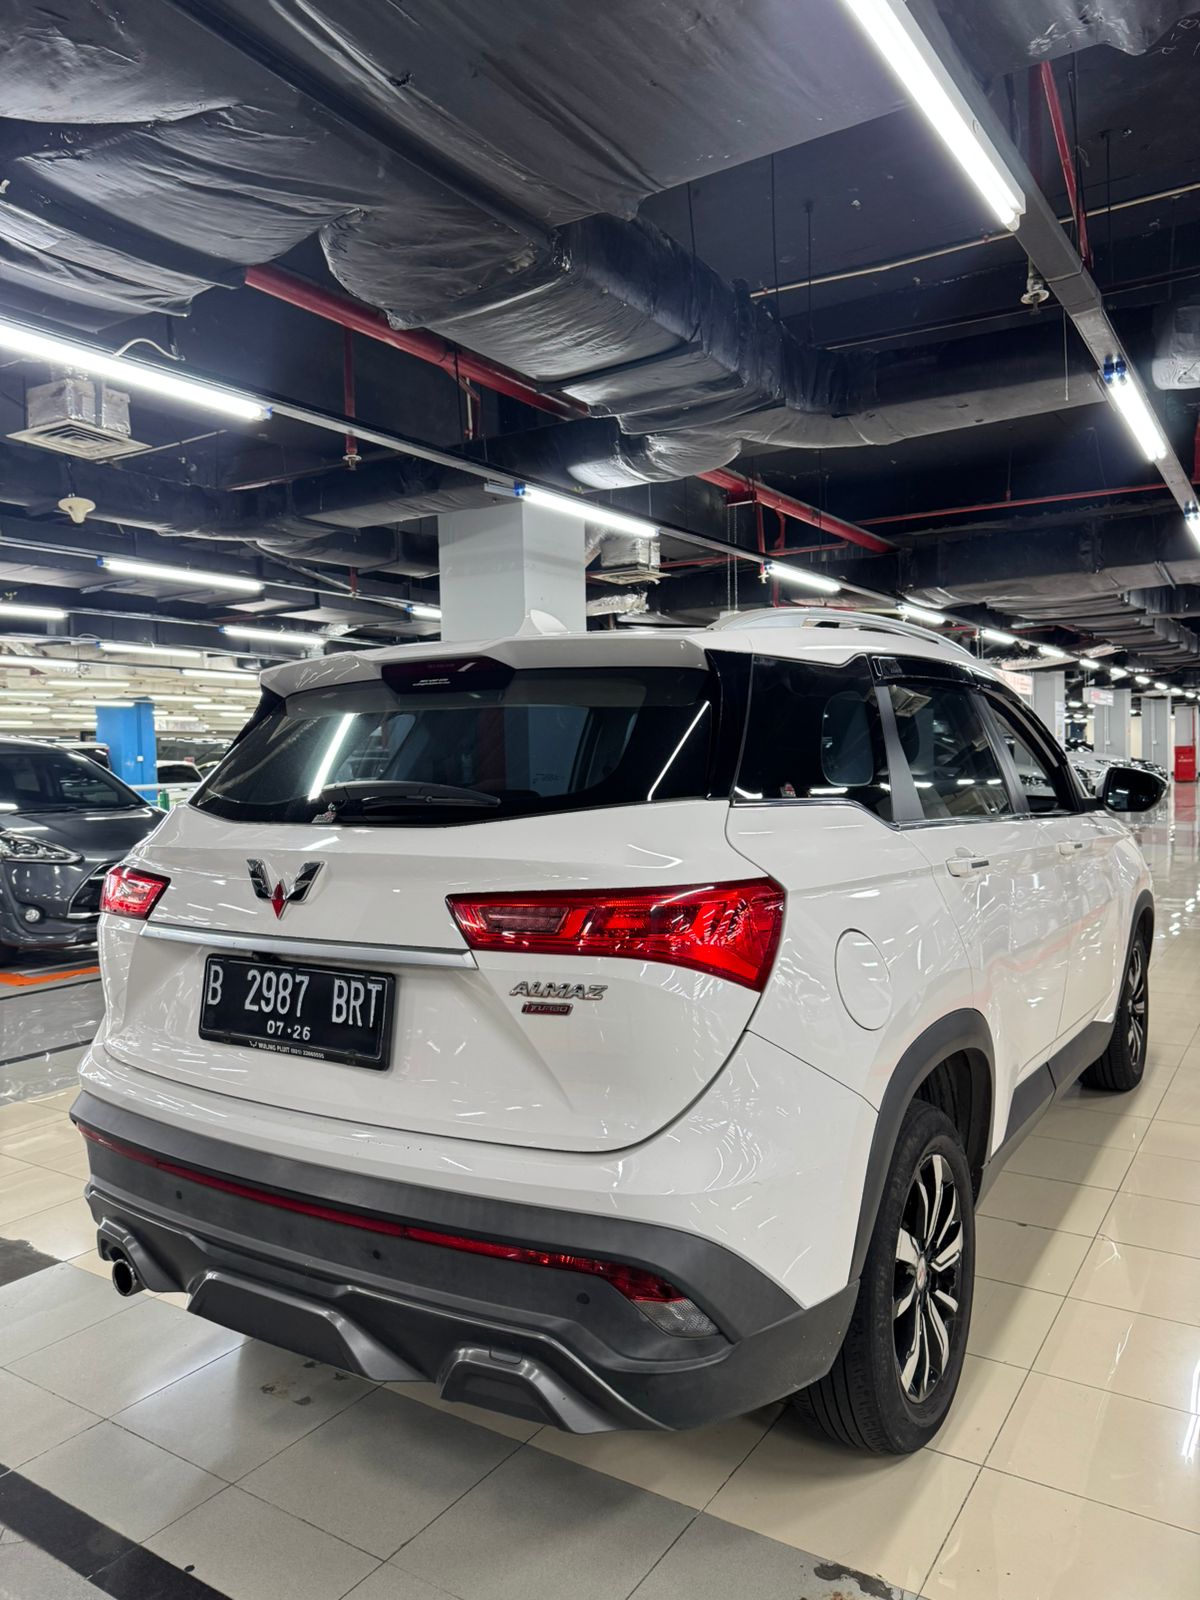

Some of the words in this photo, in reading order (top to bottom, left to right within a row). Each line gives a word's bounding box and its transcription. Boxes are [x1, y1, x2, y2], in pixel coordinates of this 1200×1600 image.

[207, 965, 224, 1005] B
[244, 969, 310, 1018] 2987
[331, 978, 383, 1028] BRT
[509, 981, 608, 1001] ALMAZ
[258, 1042, 276, 1051] WULING
